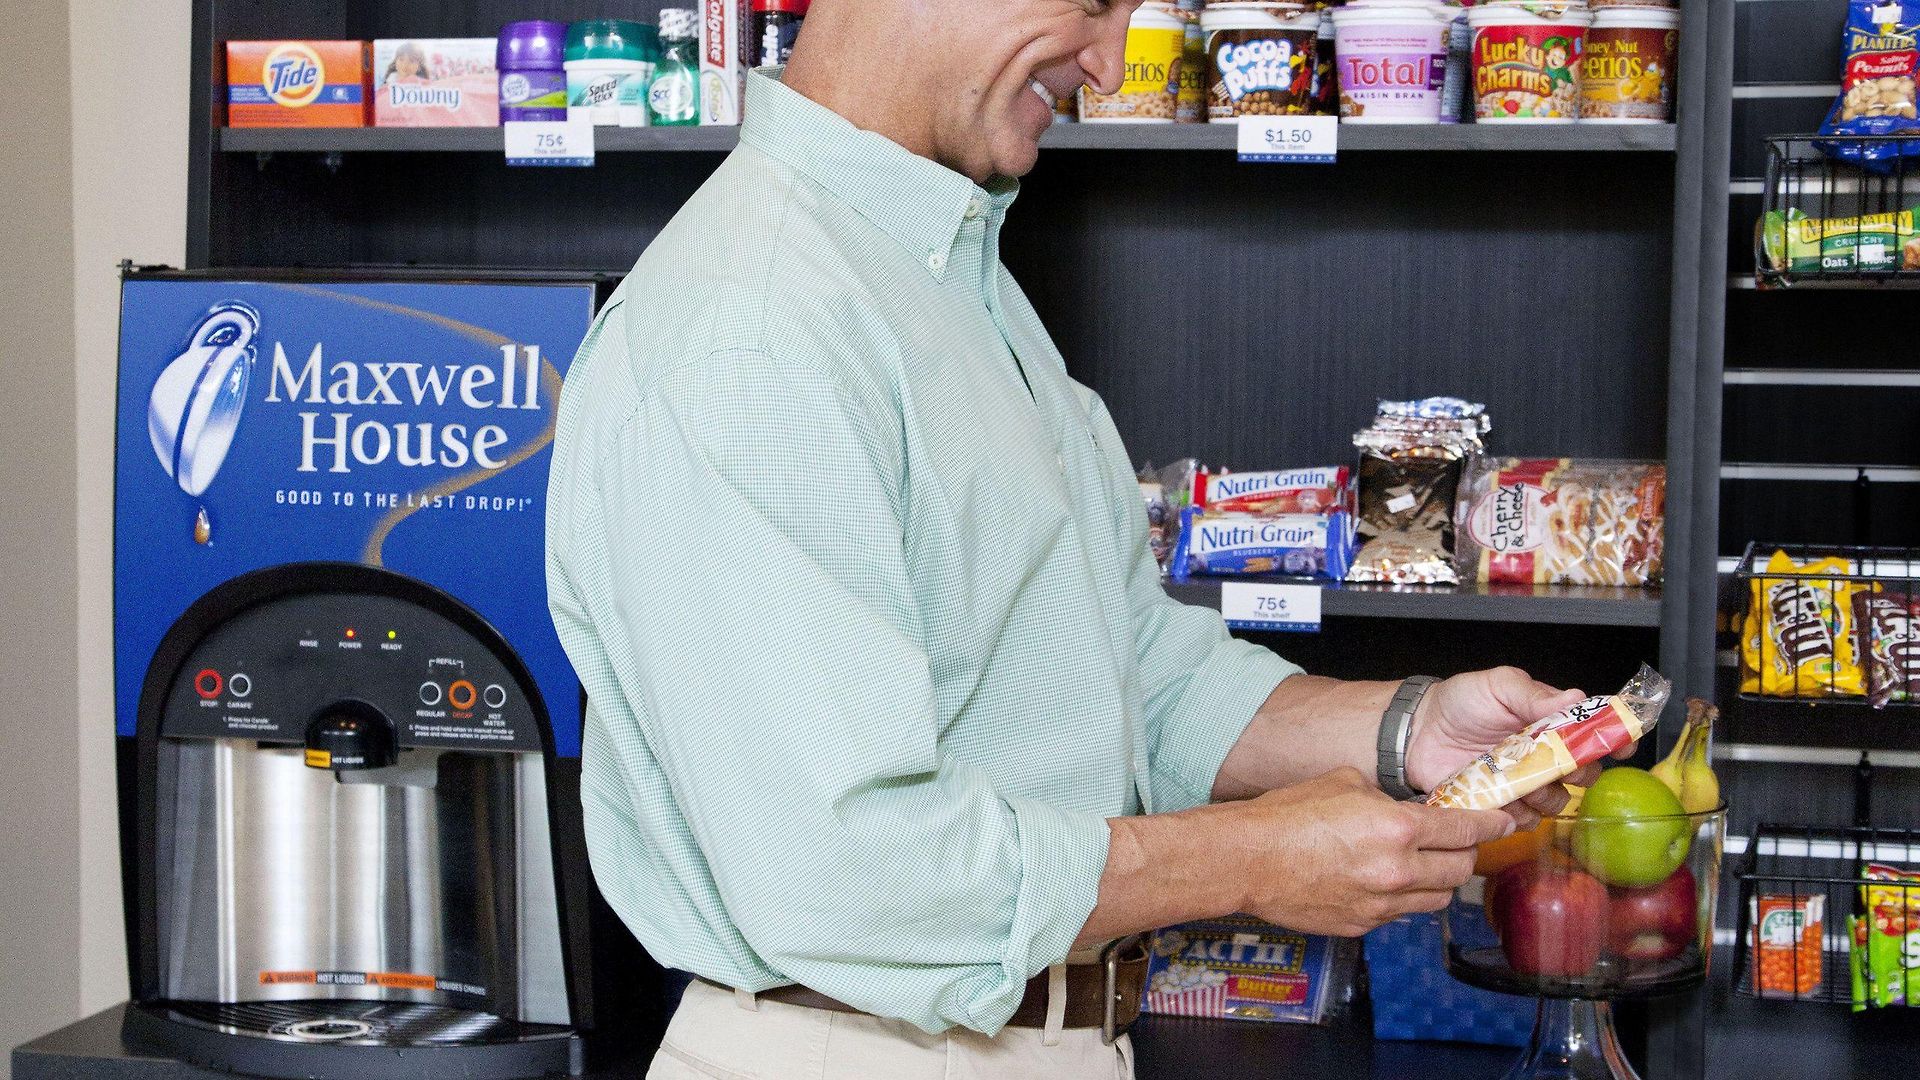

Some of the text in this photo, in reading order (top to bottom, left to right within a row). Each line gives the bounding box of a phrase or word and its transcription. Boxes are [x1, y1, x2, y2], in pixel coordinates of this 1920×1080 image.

[707, 0, 723, 61] olgate
[1851, 33, 1917, 50] PLANTERS
[1216, 40, 1292, 72] Cocoa
[1481, 37, 1544, 70] Lucky
[1615, 39, 1638, 53] Nut
[269, 58, 318, 95] Tide
[1125, 63, 1164, 81] erios
[1348, 57, 1425, 85] Total
[1853, 60, 1909, 73] Peanuts
[1223, 59, 1292, 100] Puffs
[1476, 66, 1551, 94] Charms
[391, 85, 461, 110] Downy
[536, 134, 564, 147] 75¢
[1265, 128, 1312, 143] $1.50
[1822, 257, 1848, 268] Oats
[264, 341, 541, 410] Maxwell
[296, 411, 508, 473] House
[1217, 474, 1268, 499] Nutri
[1275, 470, 1326, 489] Grain
[275, 489, 322, 506] GOOD
[332, 491, 354, 506] TO
[364, 491, 398, 508] THE
[407, 492, 455, 509] LAST
[1491, 487, 1515, 552] Cherry
[1508, 483, 1524, 548] & Cheese
[1201, 525, 1315, 552] Nutri Grain
[1256, 597, 1288, 610] 75¢
[1271, 611, 1290, 619] shelf
[339, 641, 362, 649] POWER
[416, 709, 446, 718] REGULAR
[1188, 934, 1260, 961] ACT
[317, 974, 334, 983] HOT
[334, 974, 365, 983] LIQUIDS
[1237, 977, 1293, 992] Butter
